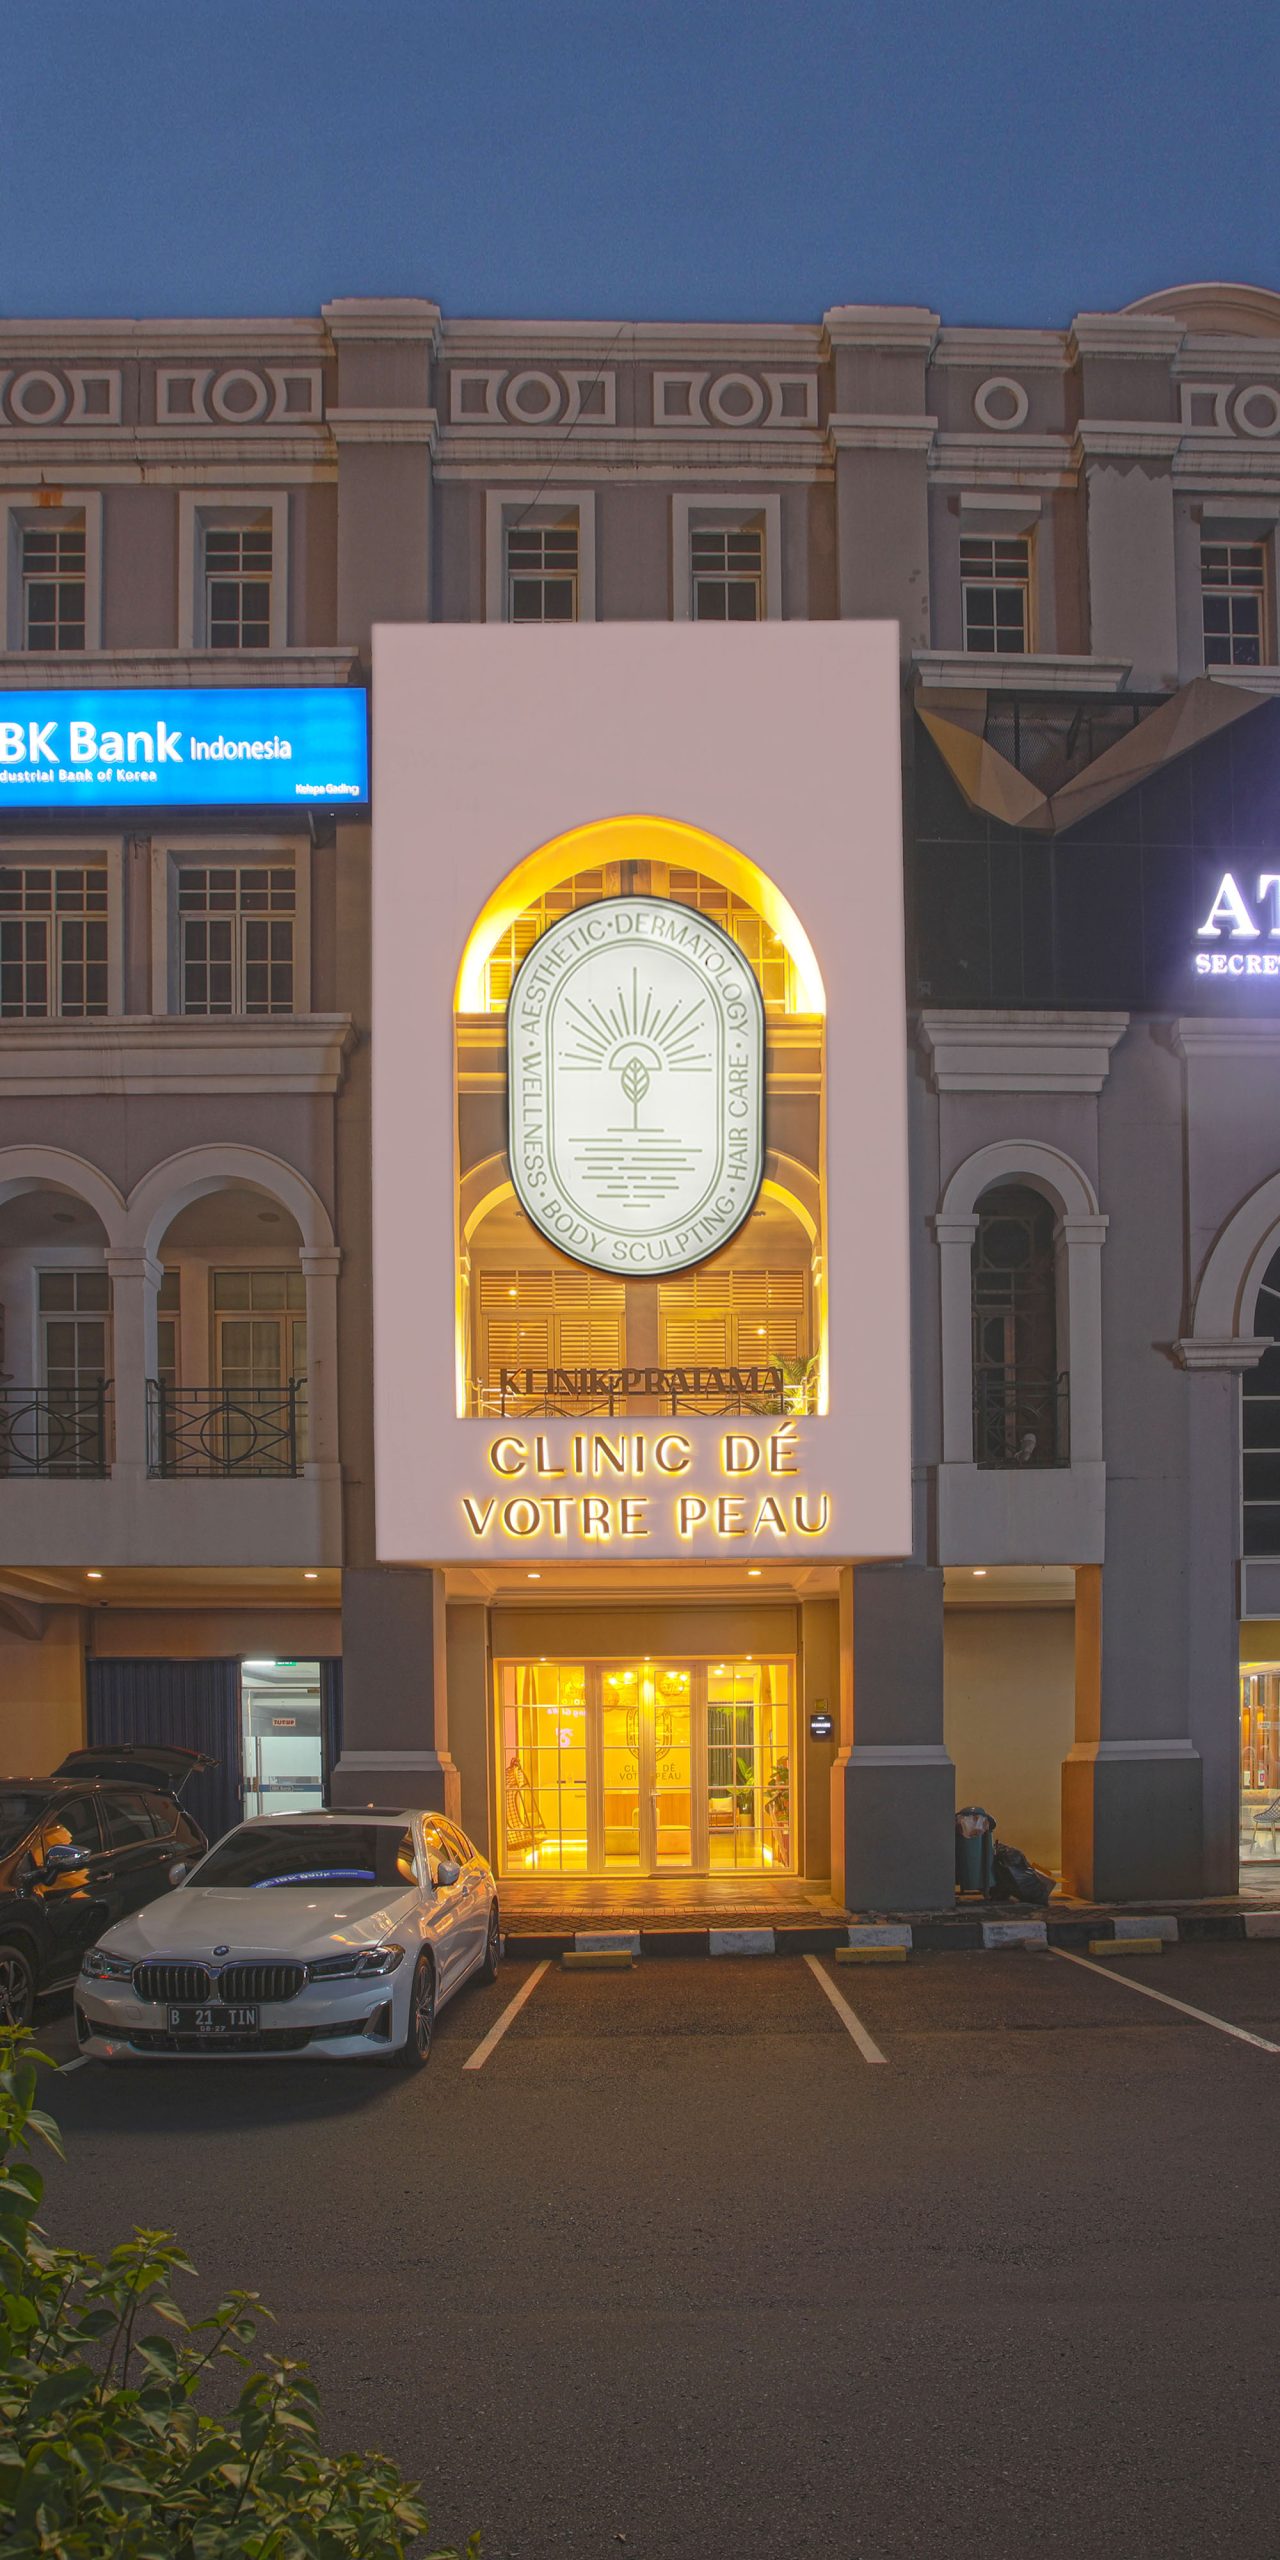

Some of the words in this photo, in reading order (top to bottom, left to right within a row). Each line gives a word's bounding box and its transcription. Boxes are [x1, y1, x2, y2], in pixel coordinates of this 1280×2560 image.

[69, 720, 184, 764] Bank
[190, 736, 293, 761] Indonesia
[58, 767, 94, 783] Bank
[97, 767, 113, 783] of
[116, 768, 158, 783] Korea
[520, 919, 606, 1036] AESTHETIC
[614, 912, 749, 1037] DERMATOLOGY
[1195, 953, 1280, 975] SECRE
[728, 1053, 749, 1118] CARE
[521, 1051, 548, 1188] WELLNESS
[726, 1127, 749, 1182] HAIR
[541, 1199, 607, 1253] BODY
[611, 1195, 736, 1262] SCULPTING
[499, 1367, 613, 1395] KLINIK
[621, 1366, 784, 1395] PRATAMA
[490, 1435, 691, 1475] CLINIC
[724, 1422, 800, 1474] DÉ
[462, 1496, 649, 1536] VOTRE
[679, 1495, 829, 1536] PEAU
[171, 2010, 180, 2025] B
[195, 2010, 213, 2025] 21
[229, 2010, 255, 2025] TIN
